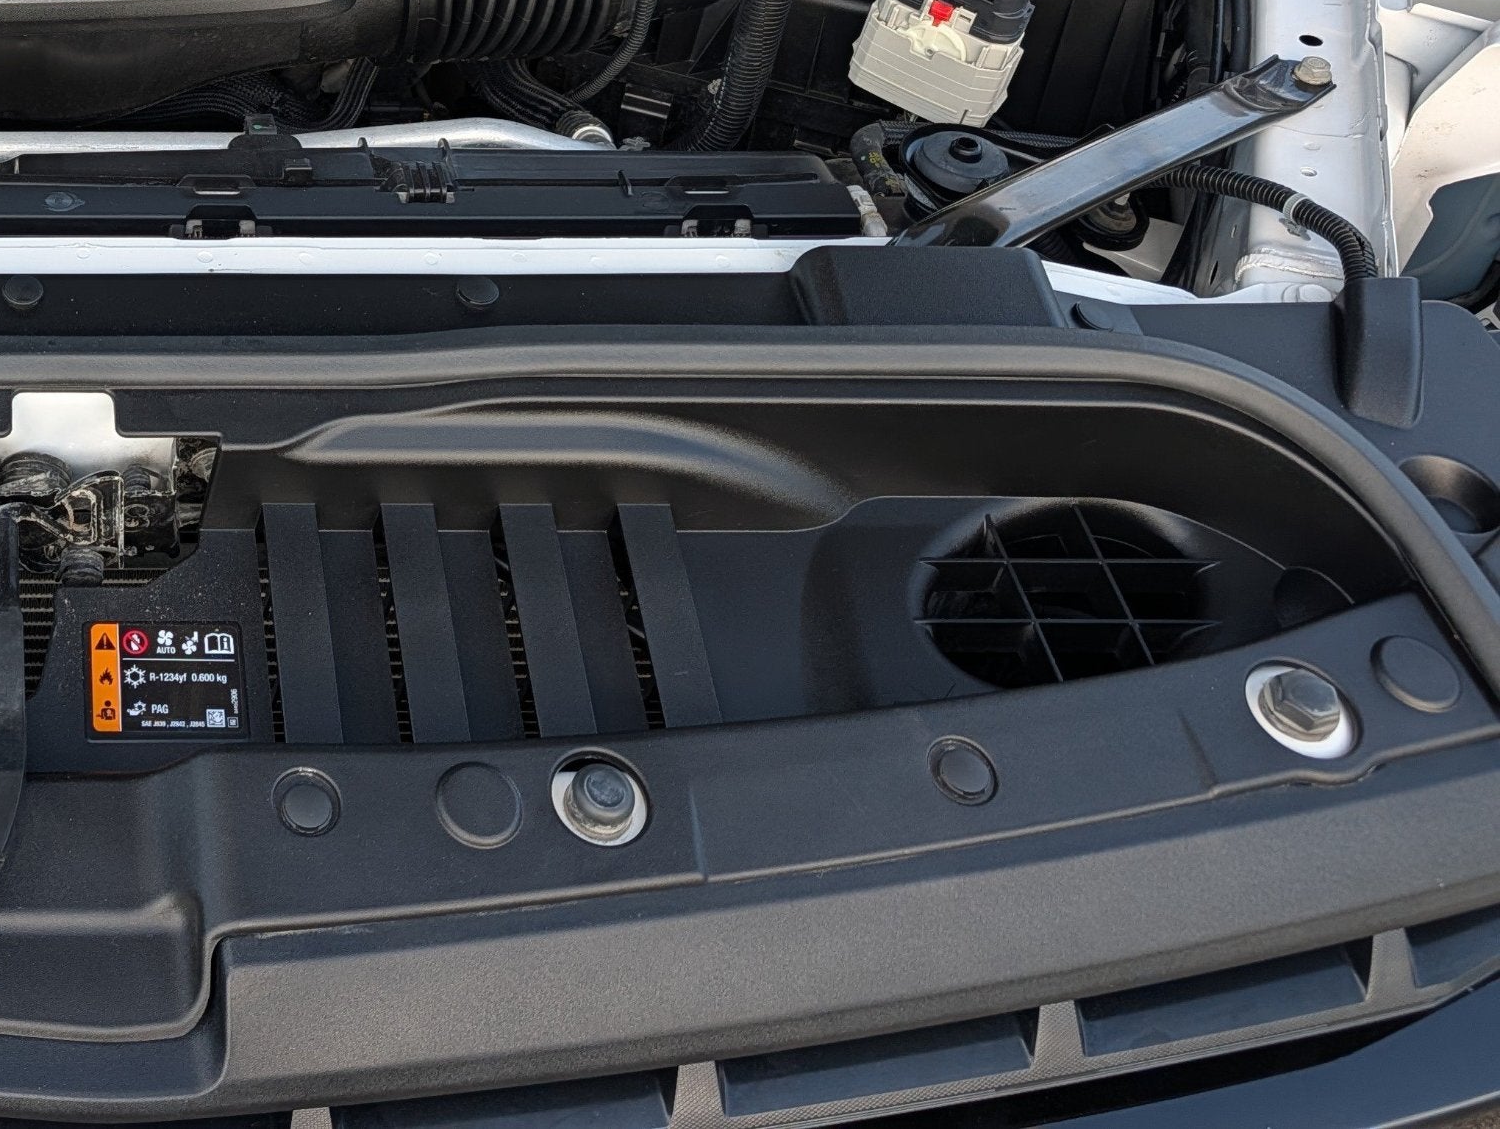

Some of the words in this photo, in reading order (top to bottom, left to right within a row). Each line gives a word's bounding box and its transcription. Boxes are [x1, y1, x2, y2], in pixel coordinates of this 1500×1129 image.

[156, 646, 176, 654] AUTO
[149, 672, 187, 683] R-1234yf
[191, 673, 215, 682] 0.600
[216, 672, 228, 684] kg
[151, 704, 169, 714] PAG
